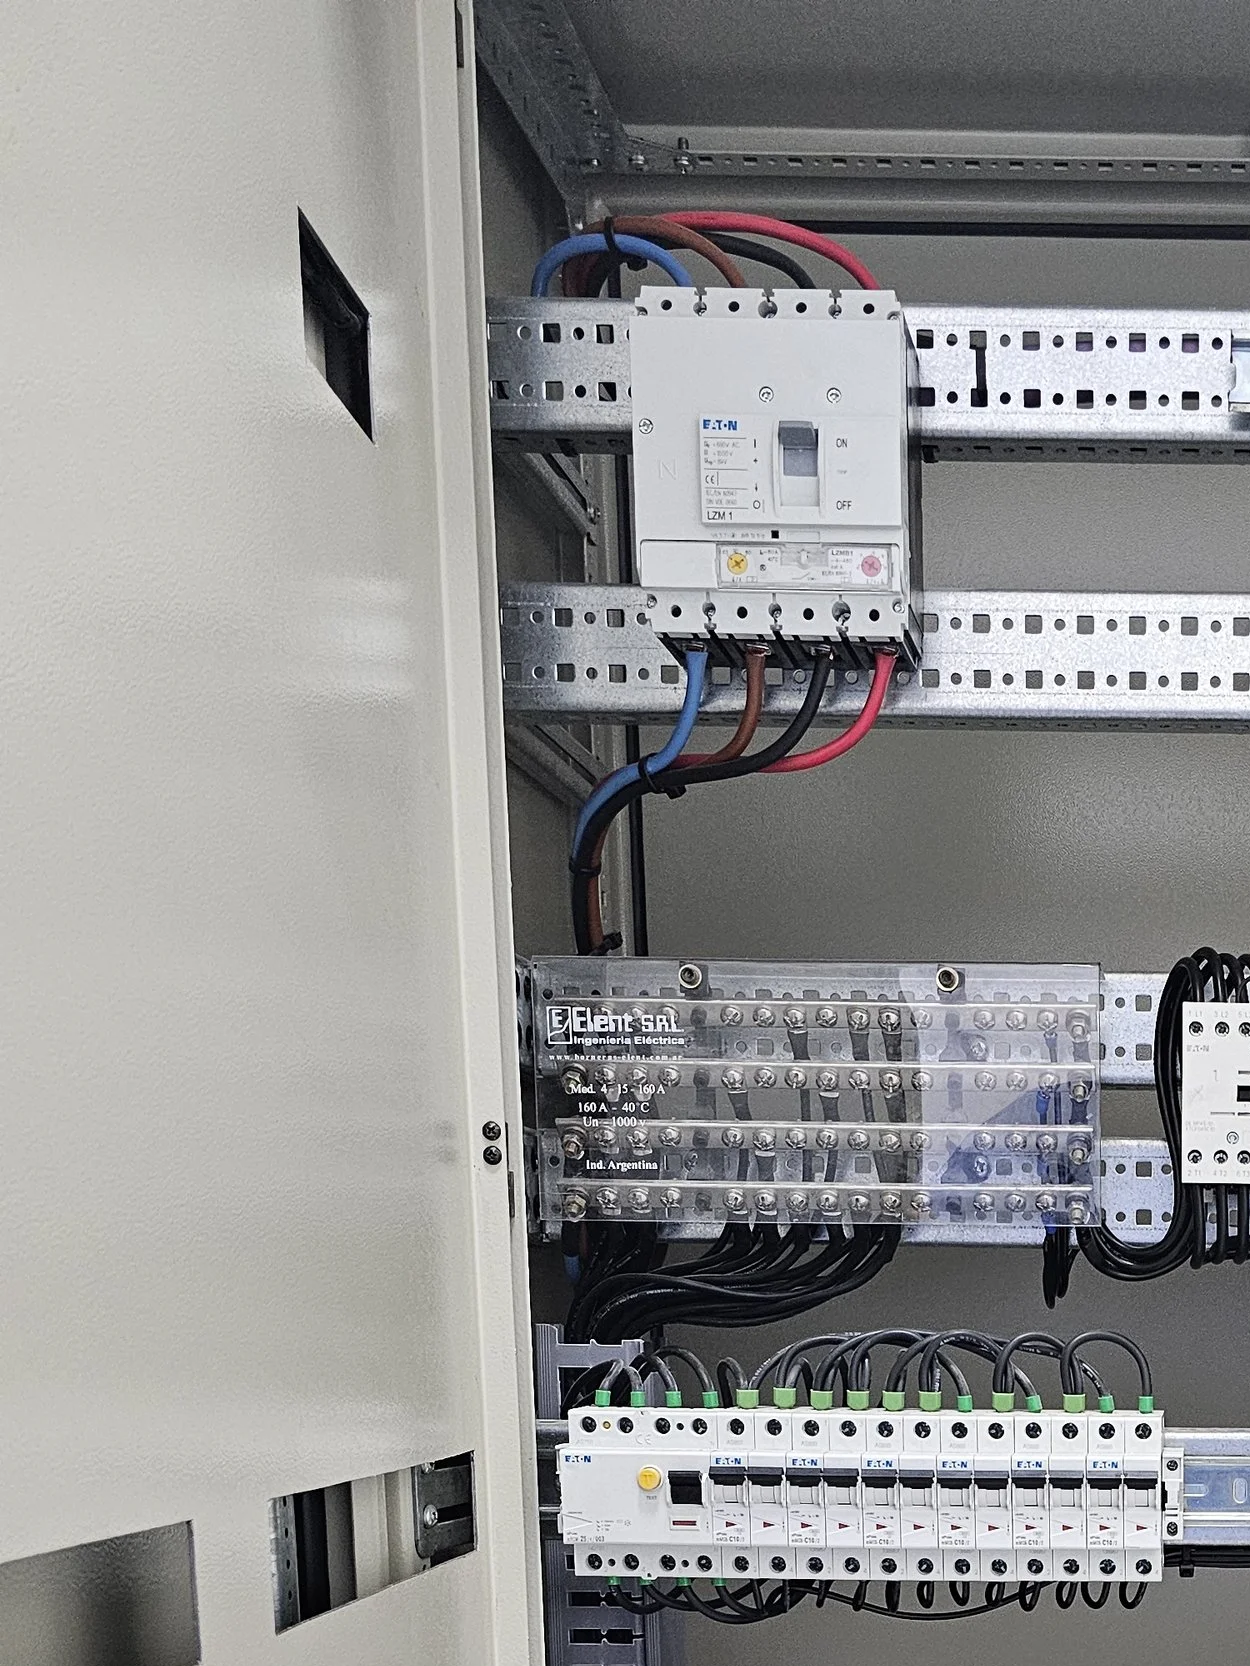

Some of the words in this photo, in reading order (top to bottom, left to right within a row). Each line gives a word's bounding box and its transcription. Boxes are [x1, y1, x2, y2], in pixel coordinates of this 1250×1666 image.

[702, 418, 738, 431] EATON
[835, 438, 848, 448] ON
[835, 500, 852, 510] OFF
[706, 511, 726, 520] LZM
[729, 511, 733, 520] 1
[572, 1007, 634, 1032] Elent
[634, 1036, 685, 1046] Eléctrica
[600, 1084, 608, 1094] 4
[617, 1084, 629, 1094] 15
[639, 1084, 656, 1094] 160
[657, 1084, 666, 1094] A
[578, 1102, 597, 1113] 160
[598, 1102, 608, 1113] A
[621, 1102, 636, 1113] 40
[583, 1117, 599, 1127] Un
[611, 1116, 637, 1127] 1000
[586, 1160, 606, 1170] Ind.
[608, 1160, 658, 1172] Argentina
